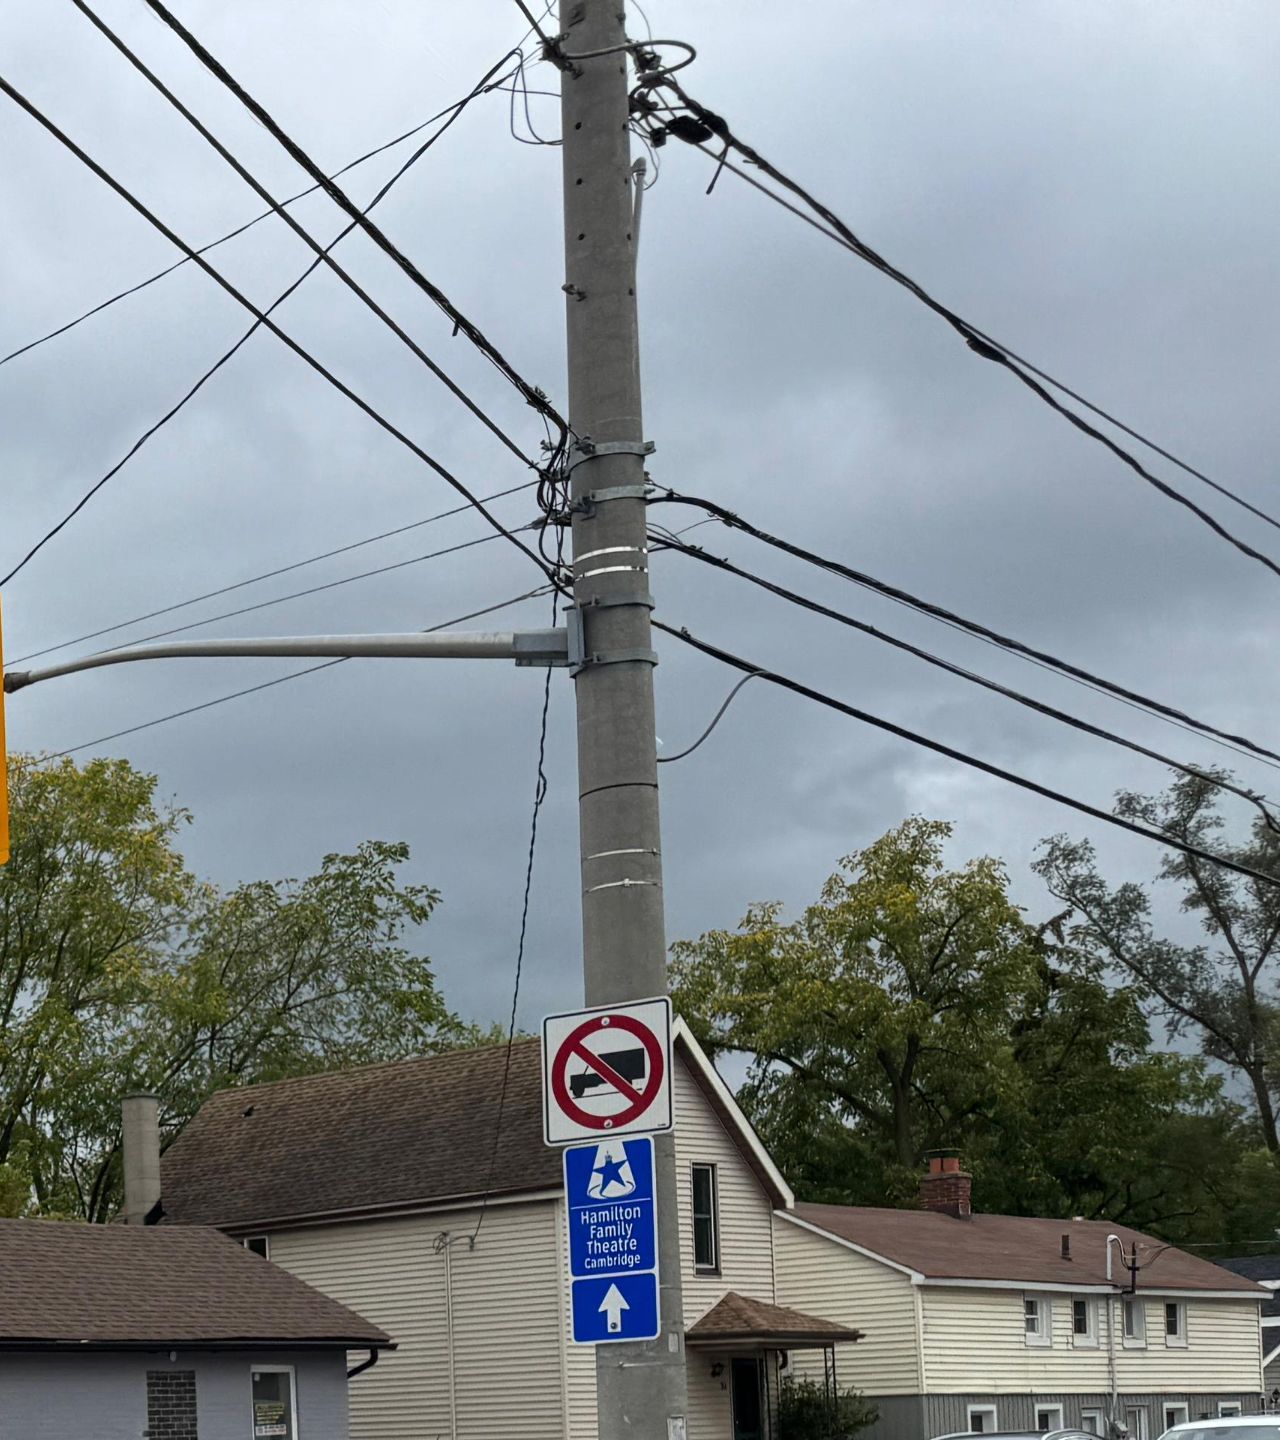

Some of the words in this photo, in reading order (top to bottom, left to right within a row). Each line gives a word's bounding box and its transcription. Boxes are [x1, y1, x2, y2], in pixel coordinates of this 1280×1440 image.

[581, 1206, 641, 1225] Hamilton
[590, 1222, 634, 1239] Family
[587, 1237, 638, 1255] Theatre
[584, 1253, 641, 1270] Cambridge
